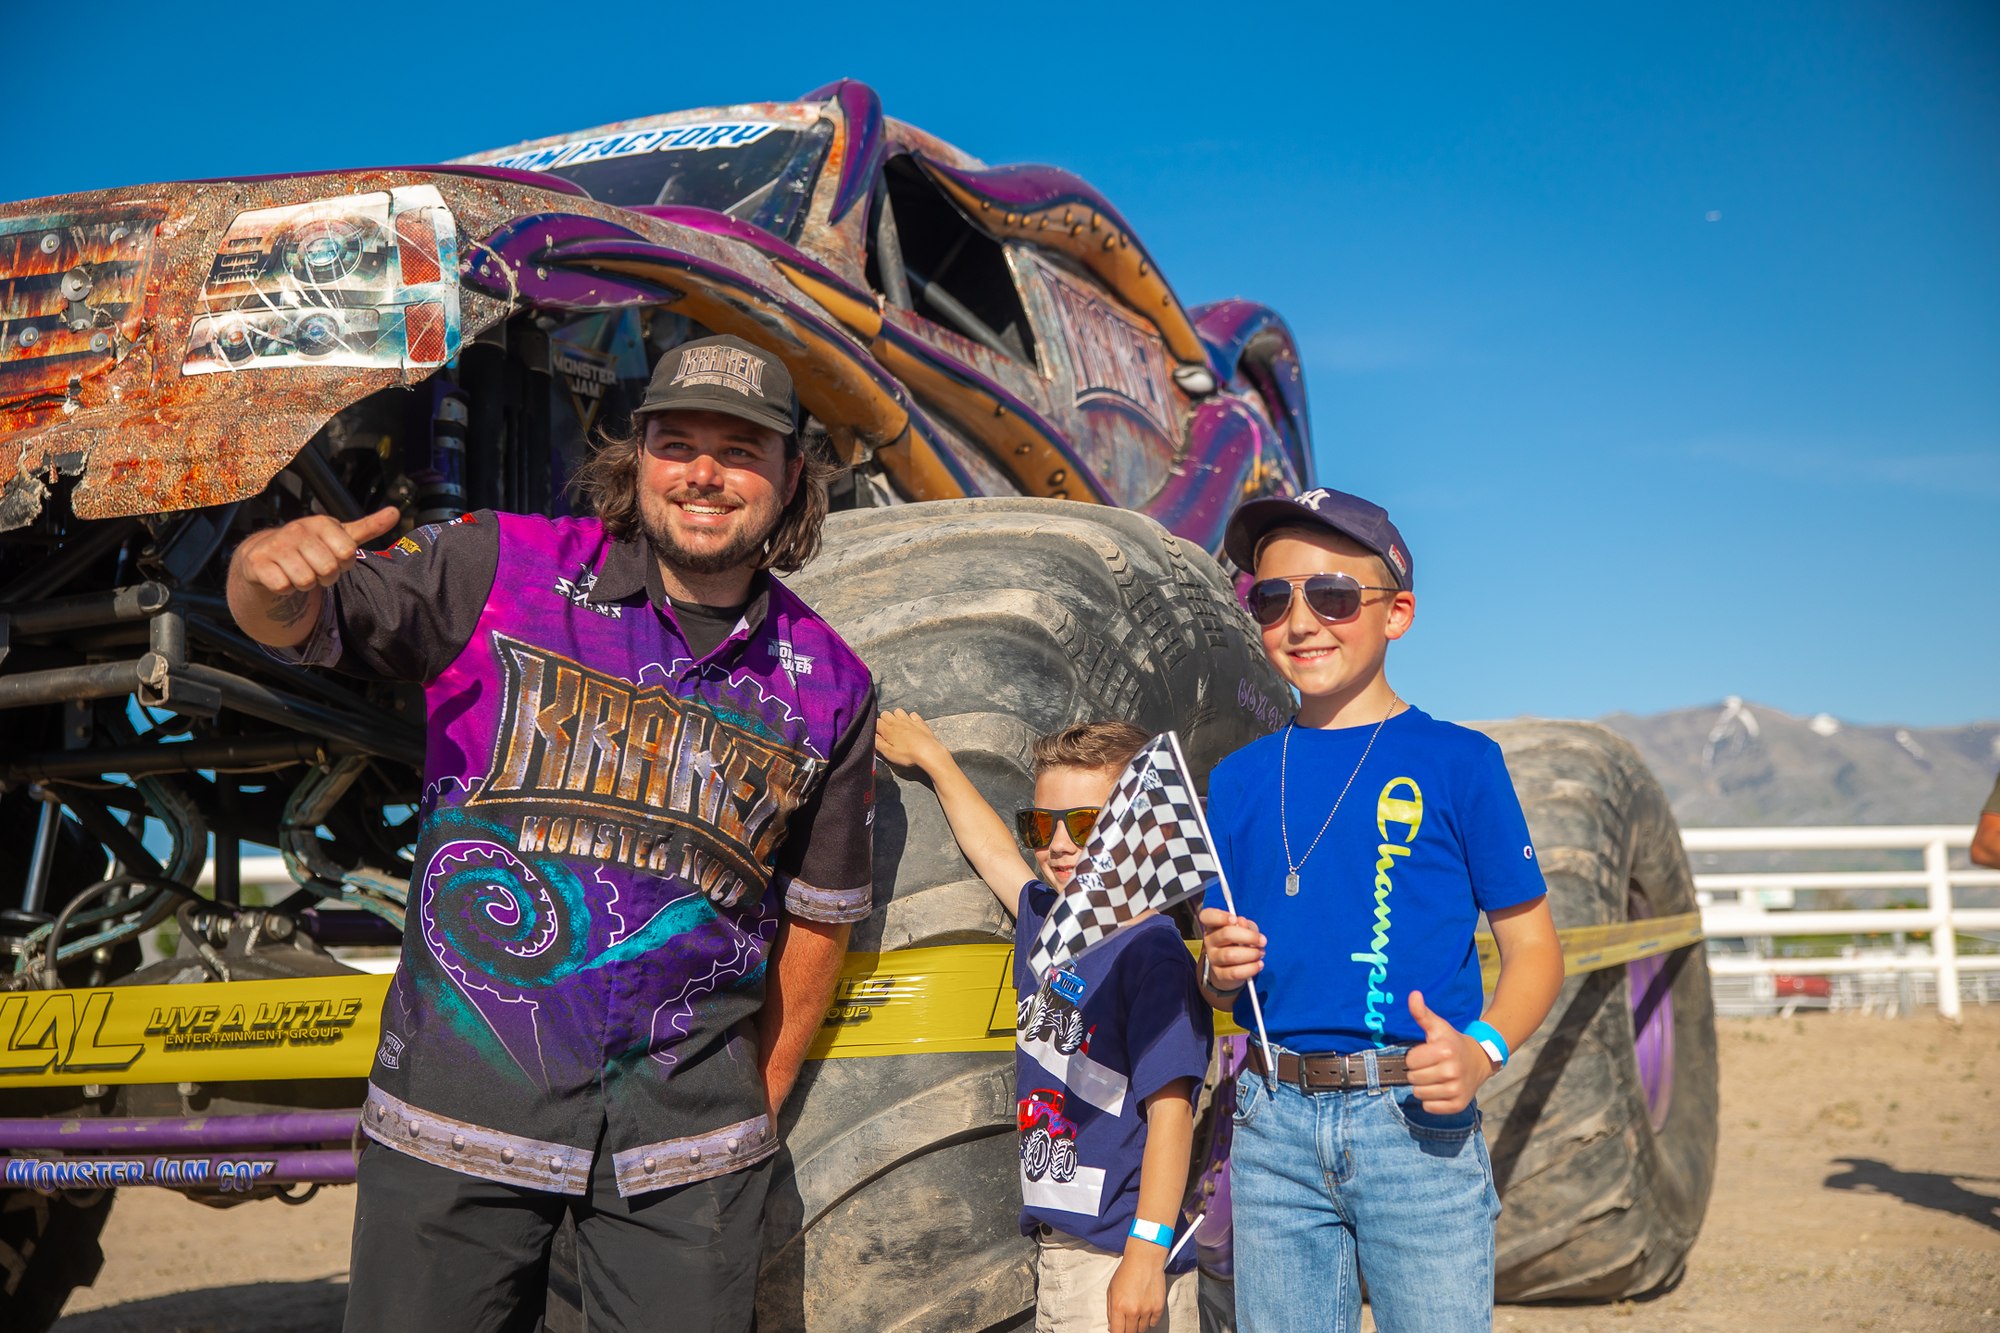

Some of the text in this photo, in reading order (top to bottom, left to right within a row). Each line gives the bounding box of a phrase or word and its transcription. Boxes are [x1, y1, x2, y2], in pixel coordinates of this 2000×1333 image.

[560, 123, 774, 164] FACTORY
[552, 355, 617, 386] MONSTER
[571, 378, 601, 399] JAM
[675, 346, 766, 394] KRAKEN
[489, 647, 812, 864] KRAKEN
[517, 815, 668, 872] MONSTER
[1350, 776, 1424, 1049] Champio
[145, 997, 363, 1035] LIVE A LITTLE
[165, 1026, 343, 1047] ENTERTAINMENT GROUP
[6, 1158, 147, 1194] MONSTER
